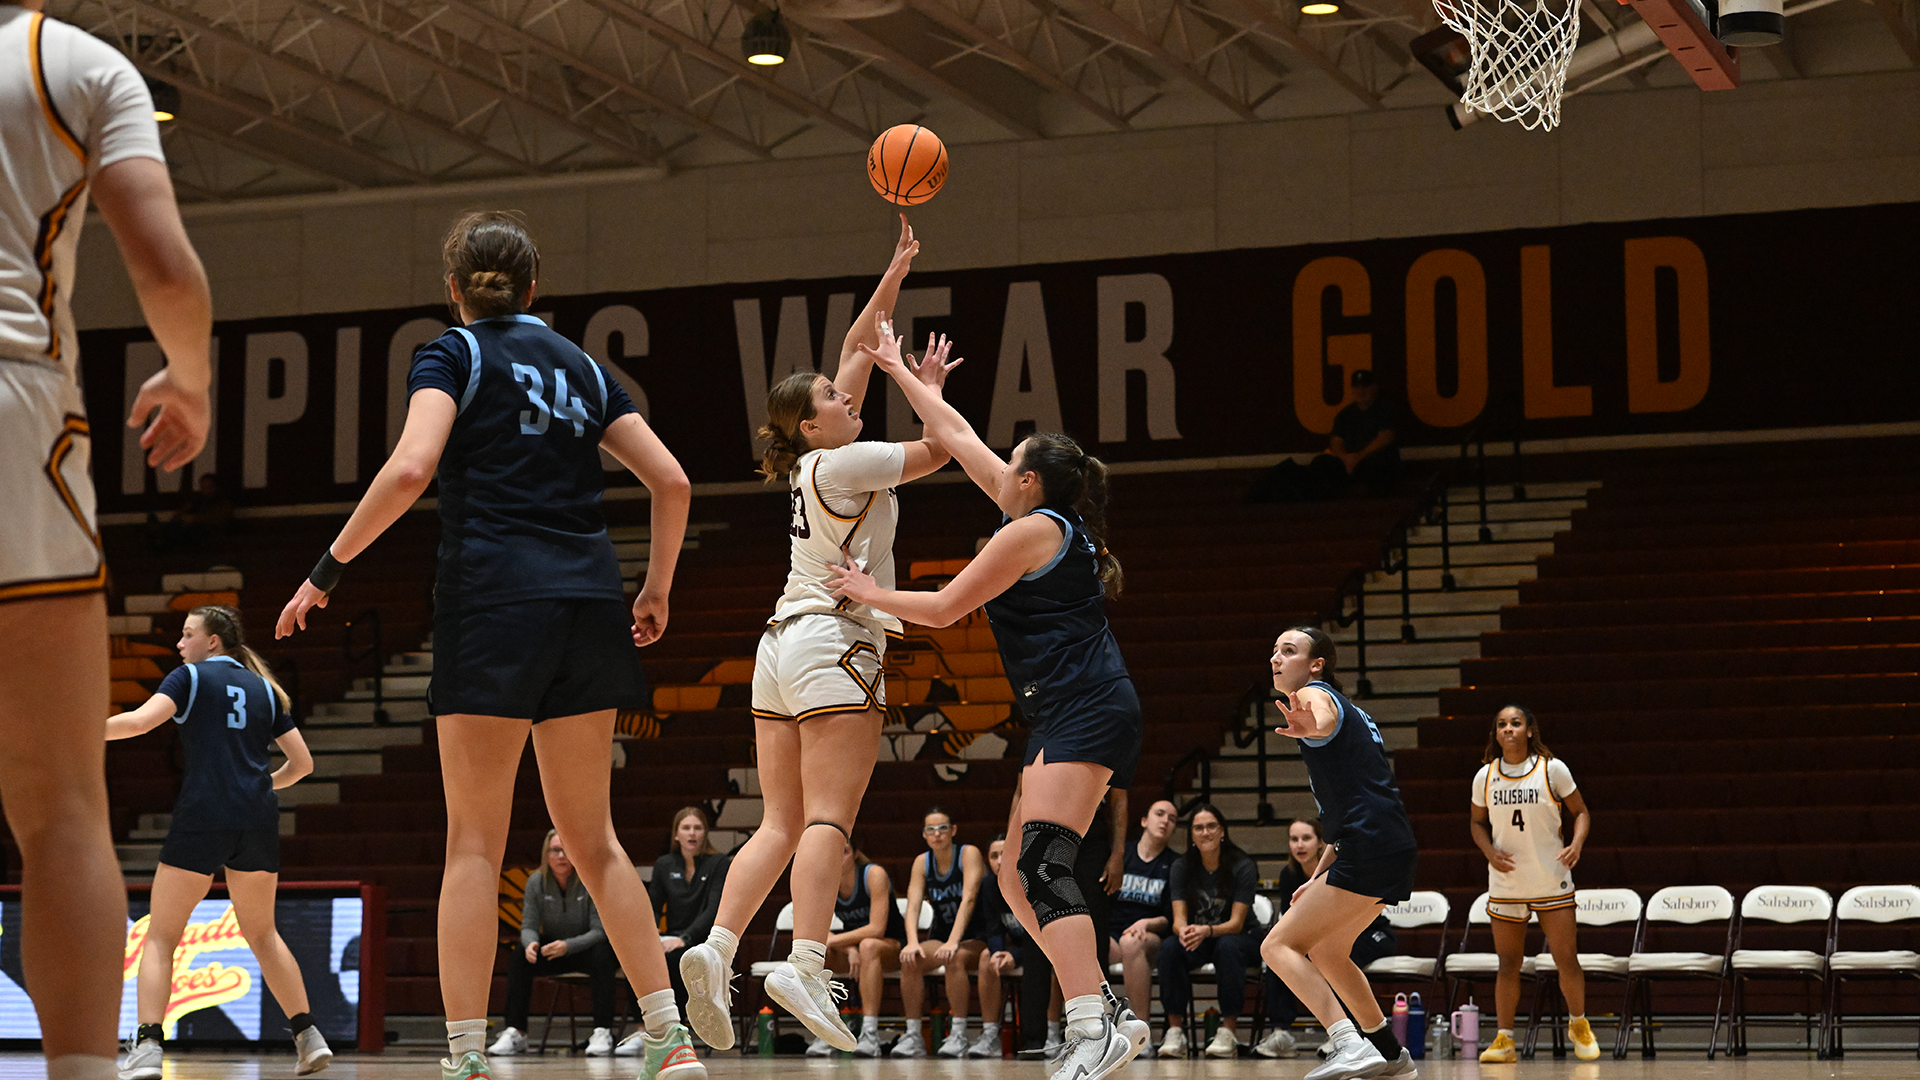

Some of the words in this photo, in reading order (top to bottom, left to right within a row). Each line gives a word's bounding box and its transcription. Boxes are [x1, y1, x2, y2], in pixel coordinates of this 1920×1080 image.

[732, 272, 1183, 464] WEAR
[1292, 235, 1712, 435] GOLD
[510, 362, 589, 438] 34
[226, 684, 247, 730] 3
[1493, 788, 1540, 806] SALISBURY
[1511, 809, 1526, 832] 4
[1121, 873, 1167, 896] UMW
[1661, 897, 1720, 913] Salisbury
[1757, 894, 1818, 911] Salisbury
[1853, 896, 1914, 912] Salisbury
